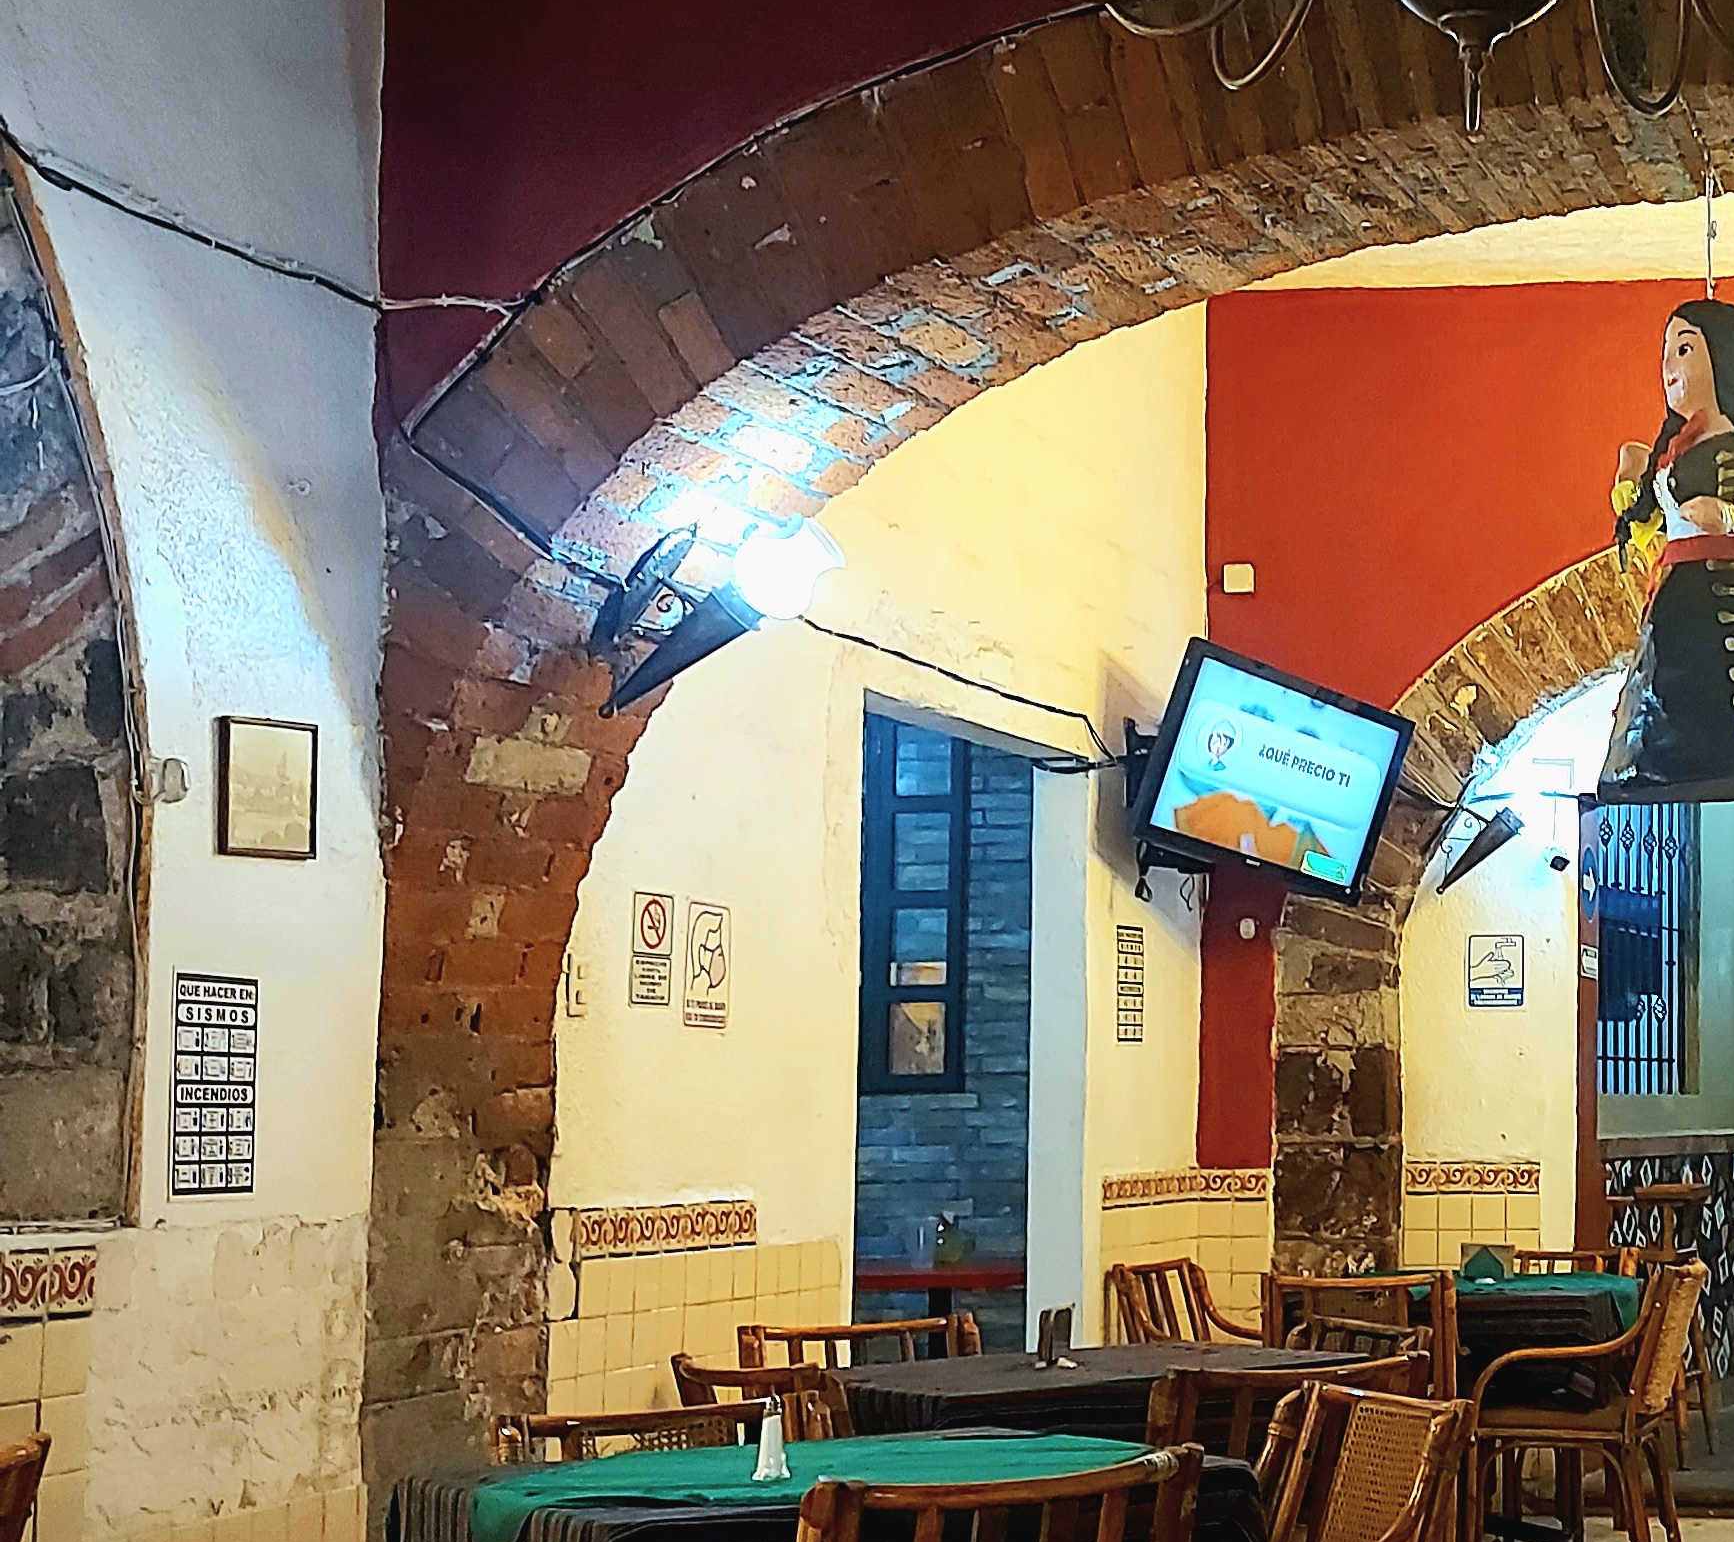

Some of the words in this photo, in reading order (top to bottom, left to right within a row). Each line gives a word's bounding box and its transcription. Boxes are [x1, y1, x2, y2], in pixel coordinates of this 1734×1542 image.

[1291, 755, 1336, 781] PRECIO
[1338, 771, 1351, 788] TI
[179, 984, 201, 997] QUE
[203, 985, 237, 999] HACER
[185, 1006, 249, 1024] SISMOS
[180, 1086, 248, 1102] INCENDIOS
